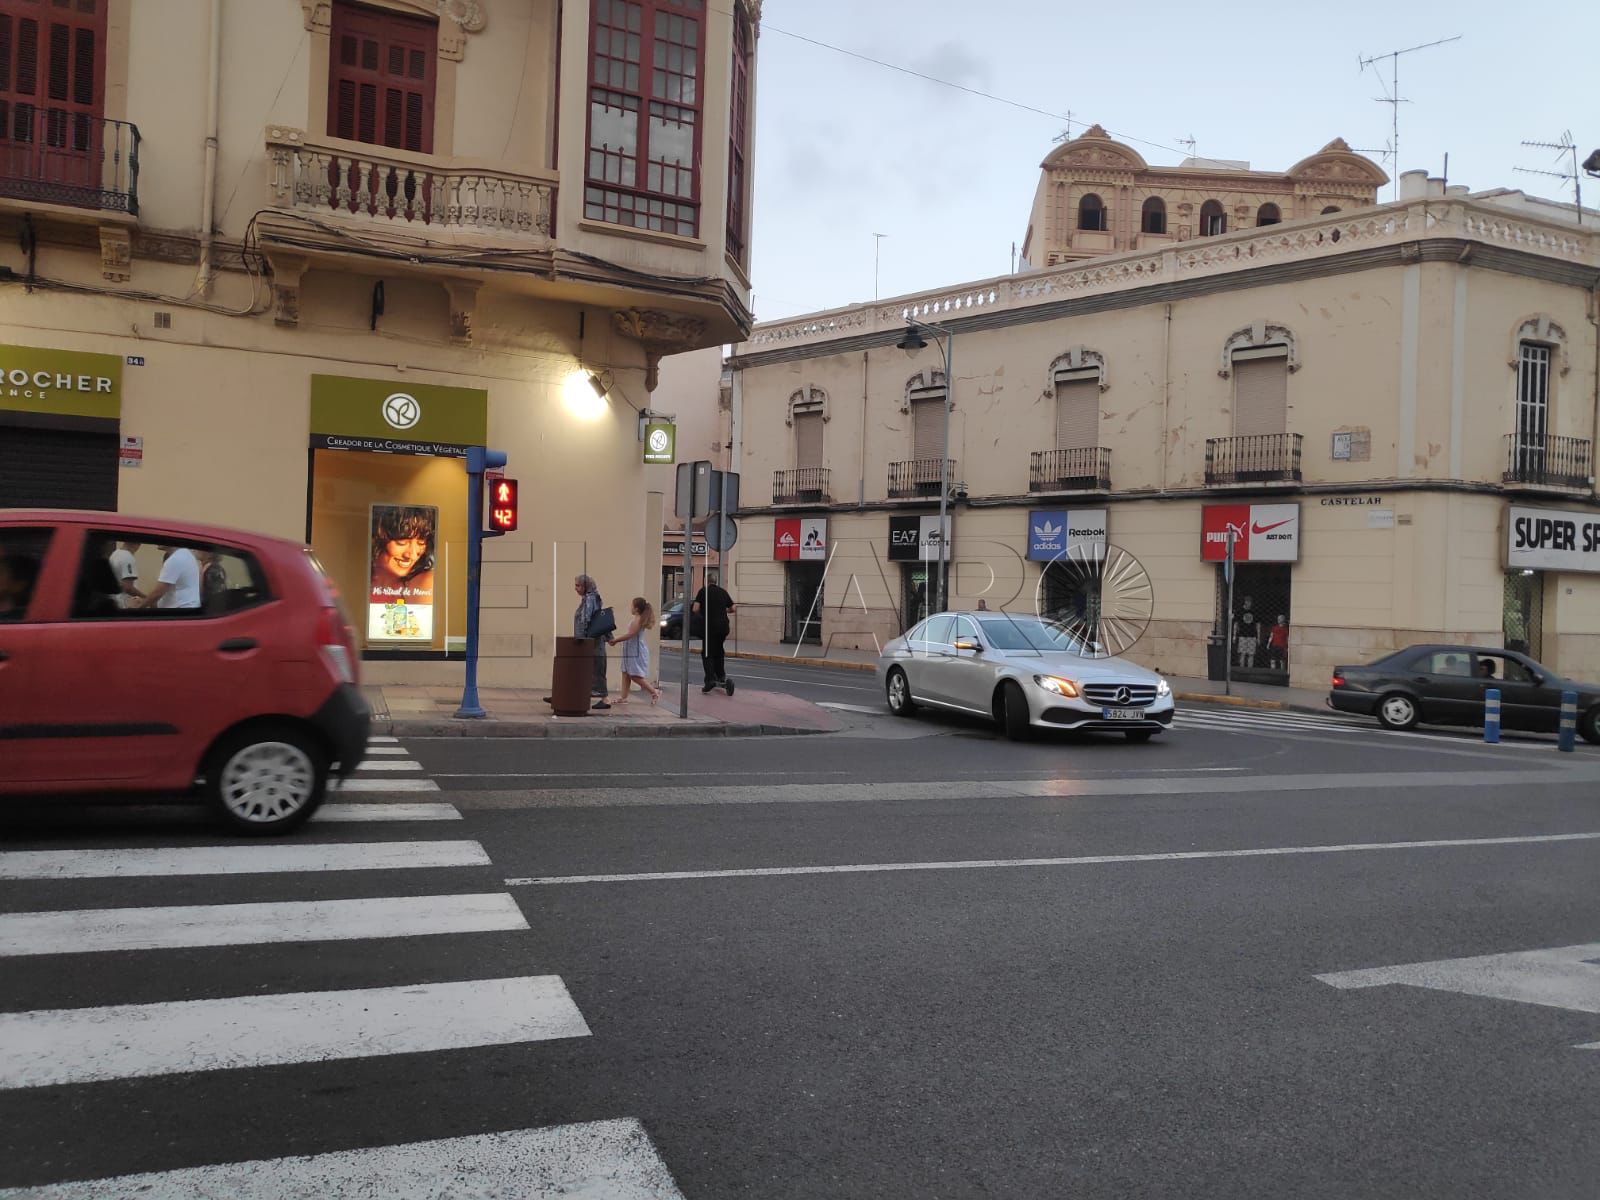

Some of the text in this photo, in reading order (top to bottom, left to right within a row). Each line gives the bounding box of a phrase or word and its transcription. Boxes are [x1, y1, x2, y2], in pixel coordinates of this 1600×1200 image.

[1320, 497, 1382, 506] CASTELAR
[495, 510, 512, 524] 42
[892, 530, 918, 543] EA7
[1068, 528, 1105, 537] Reebok
[1515, 516, 1576, 551] SUPER
[1033, 541, 1062, 550] adidas
[1109, 710, 1126, 719] 5824
